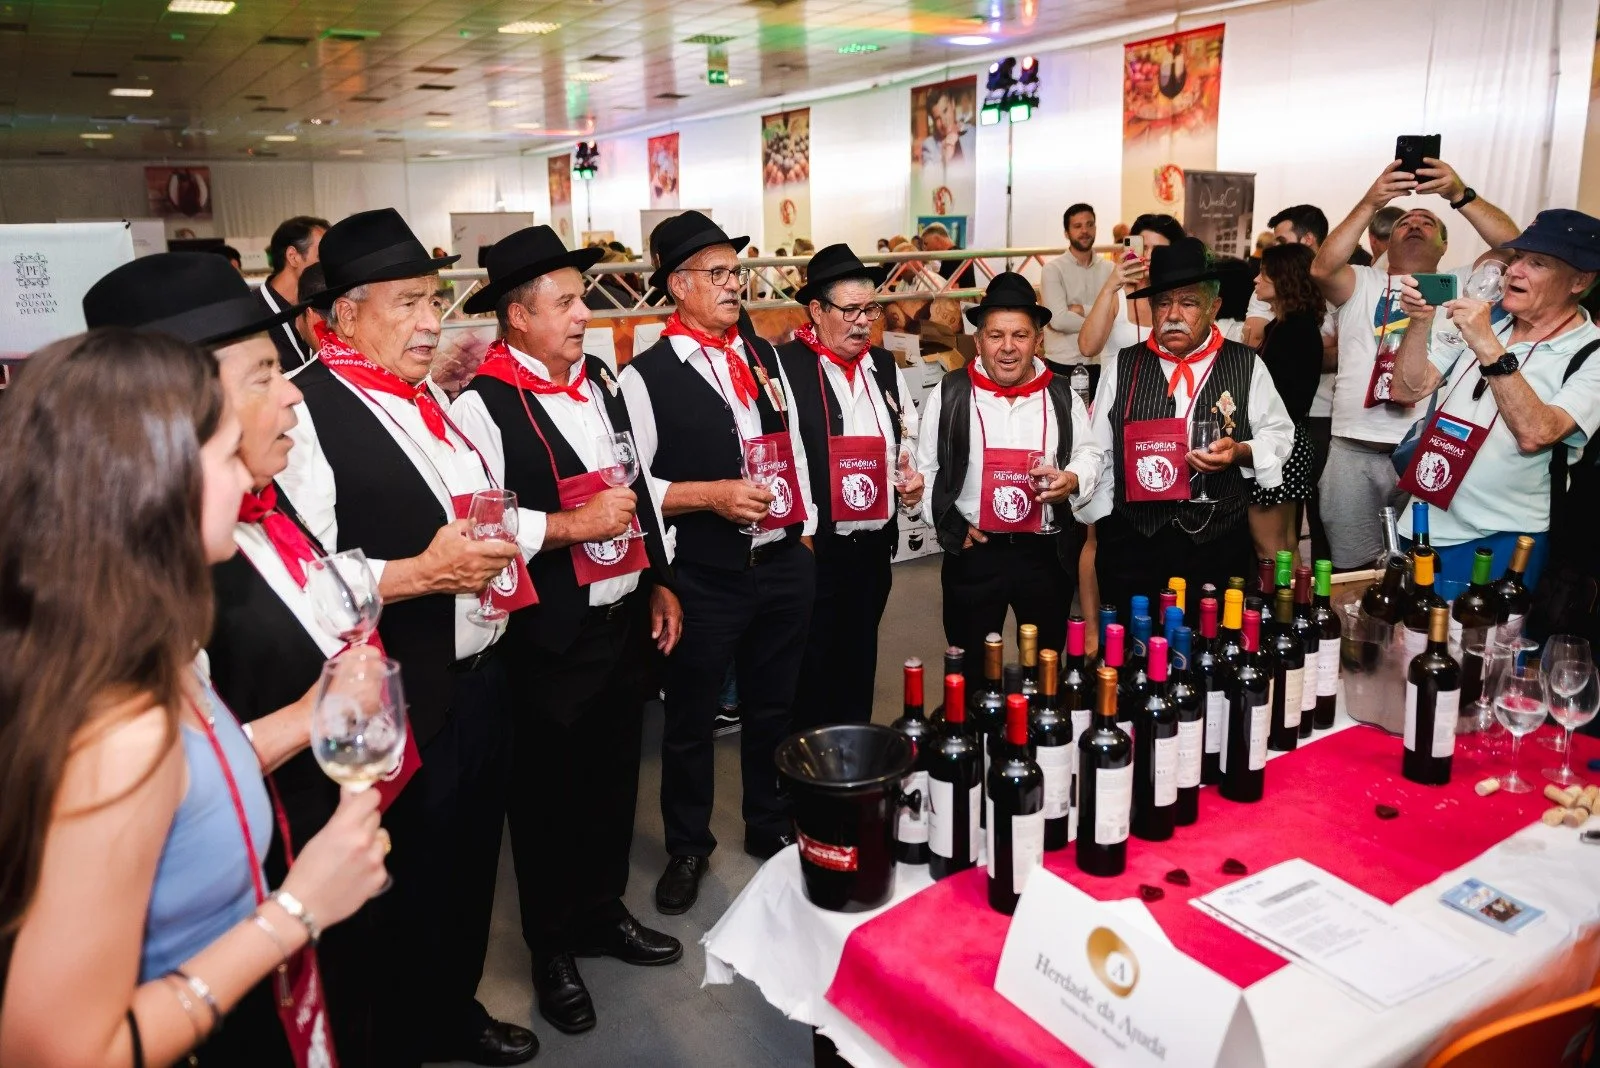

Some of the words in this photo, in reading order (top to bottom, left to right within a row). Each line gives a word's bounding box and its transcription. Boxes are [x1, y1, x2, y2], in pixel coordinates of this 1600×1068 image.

[25, 265, 39, 276] PF
[18, 292, 52, 300] QUINTA
[15, 300, 58, 308] POUSADA
[20, 307, 32, 315] DE
[1111, 961, 1126, 982] A
[1035, 952, 1095, 1007] Herdade
[1096, 1000, 1116, 1024] da
[1117, 1013, 1168, 1061] Ajuda
